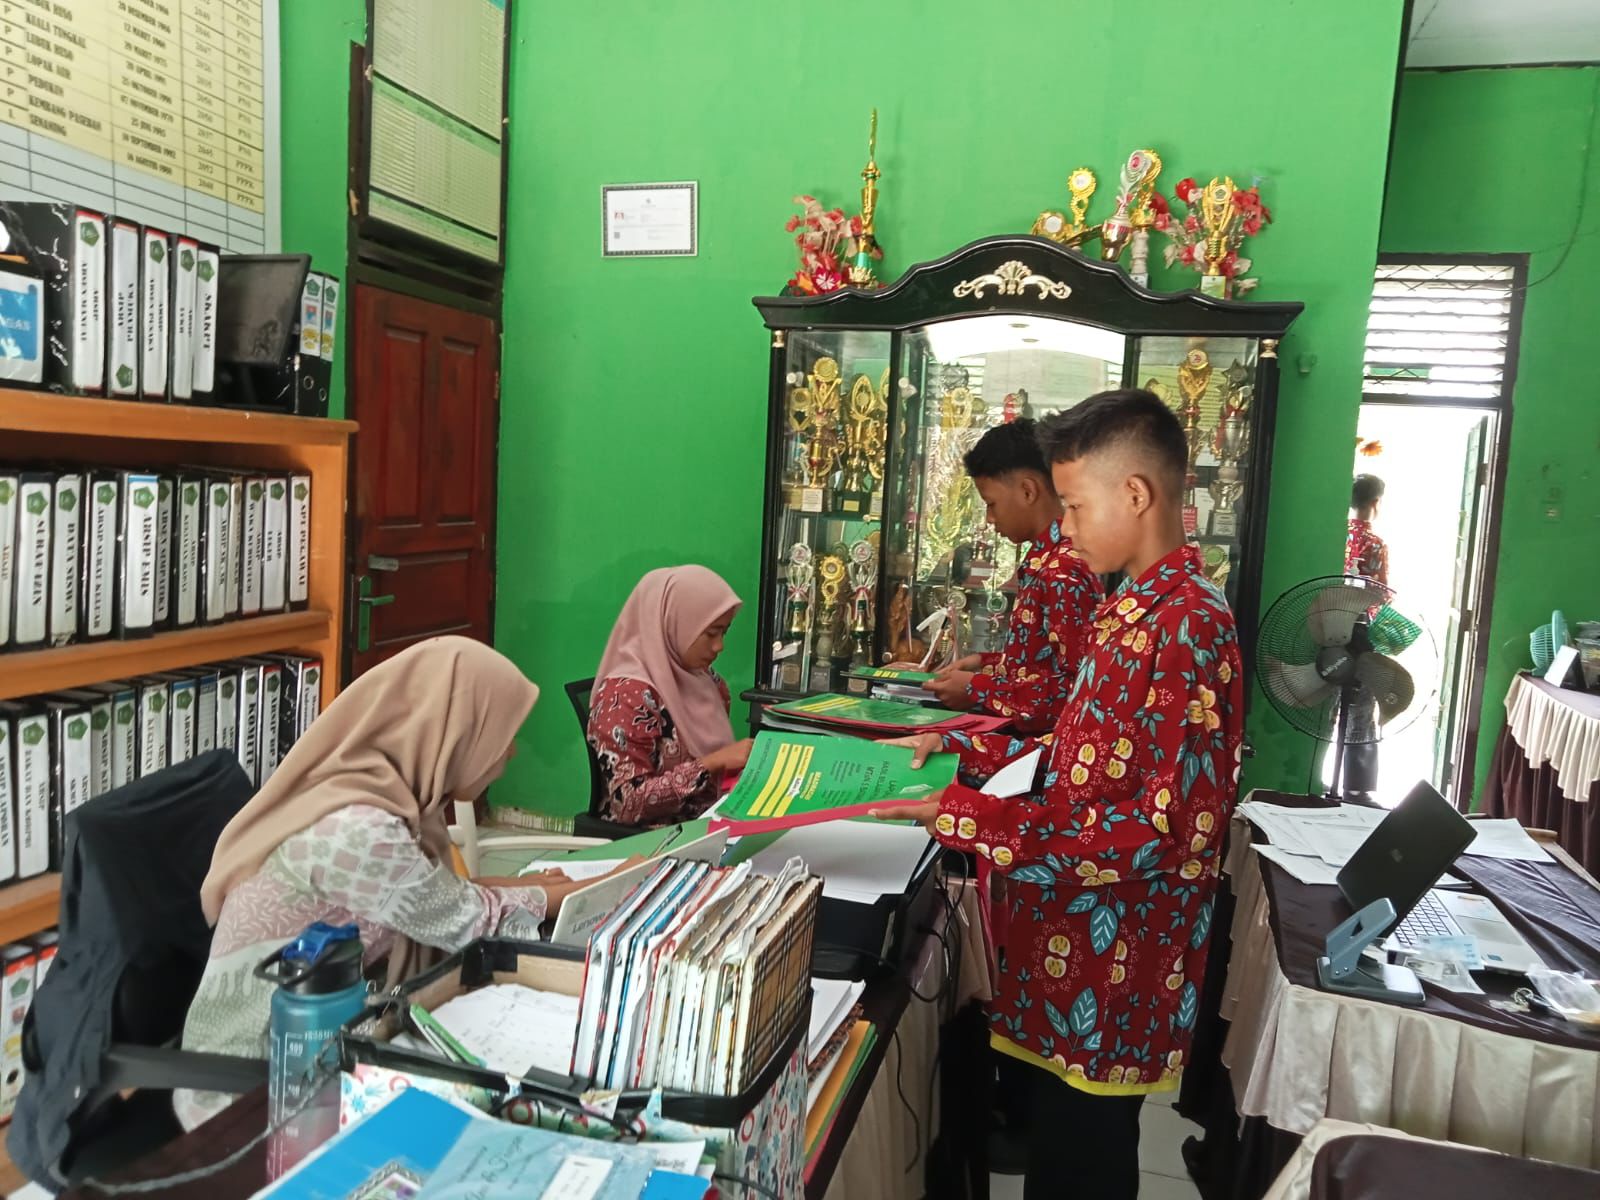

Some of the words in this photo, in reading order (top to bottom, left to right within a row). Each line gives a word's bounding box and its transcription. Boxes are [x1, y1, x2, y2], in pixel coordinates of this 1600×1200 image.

[92, 290, 100, 321] ARSIP
[66, 522, 76, 563] DATA
[97, 508, 105, 542] ARSIP
[142, 514, 152, 557] ARSIP
[160, 509, 169, 546] ABSEN
[220, 520, 228, 548] ARSIP
[1, 543, 10, 581] ARSIP
[35, 520, 45, 569] SURAT
[95, 544, 103, 580] SURAT
[299, 530, 307, 586] PEGAWAI
[140, 560, 151, 597] EMIS
[246, 536, 254, 593] KURIKULUM
[32, 573, 43, 606] IZIN
[65, 565, 75, 614] SISWA
[93, 583, 102, 629] KELUAR
[270, 695, 278, 734] ARSIP
[101, 733, 109, 767] ARSIP
[246, 702, 257, 768] KOMITE
